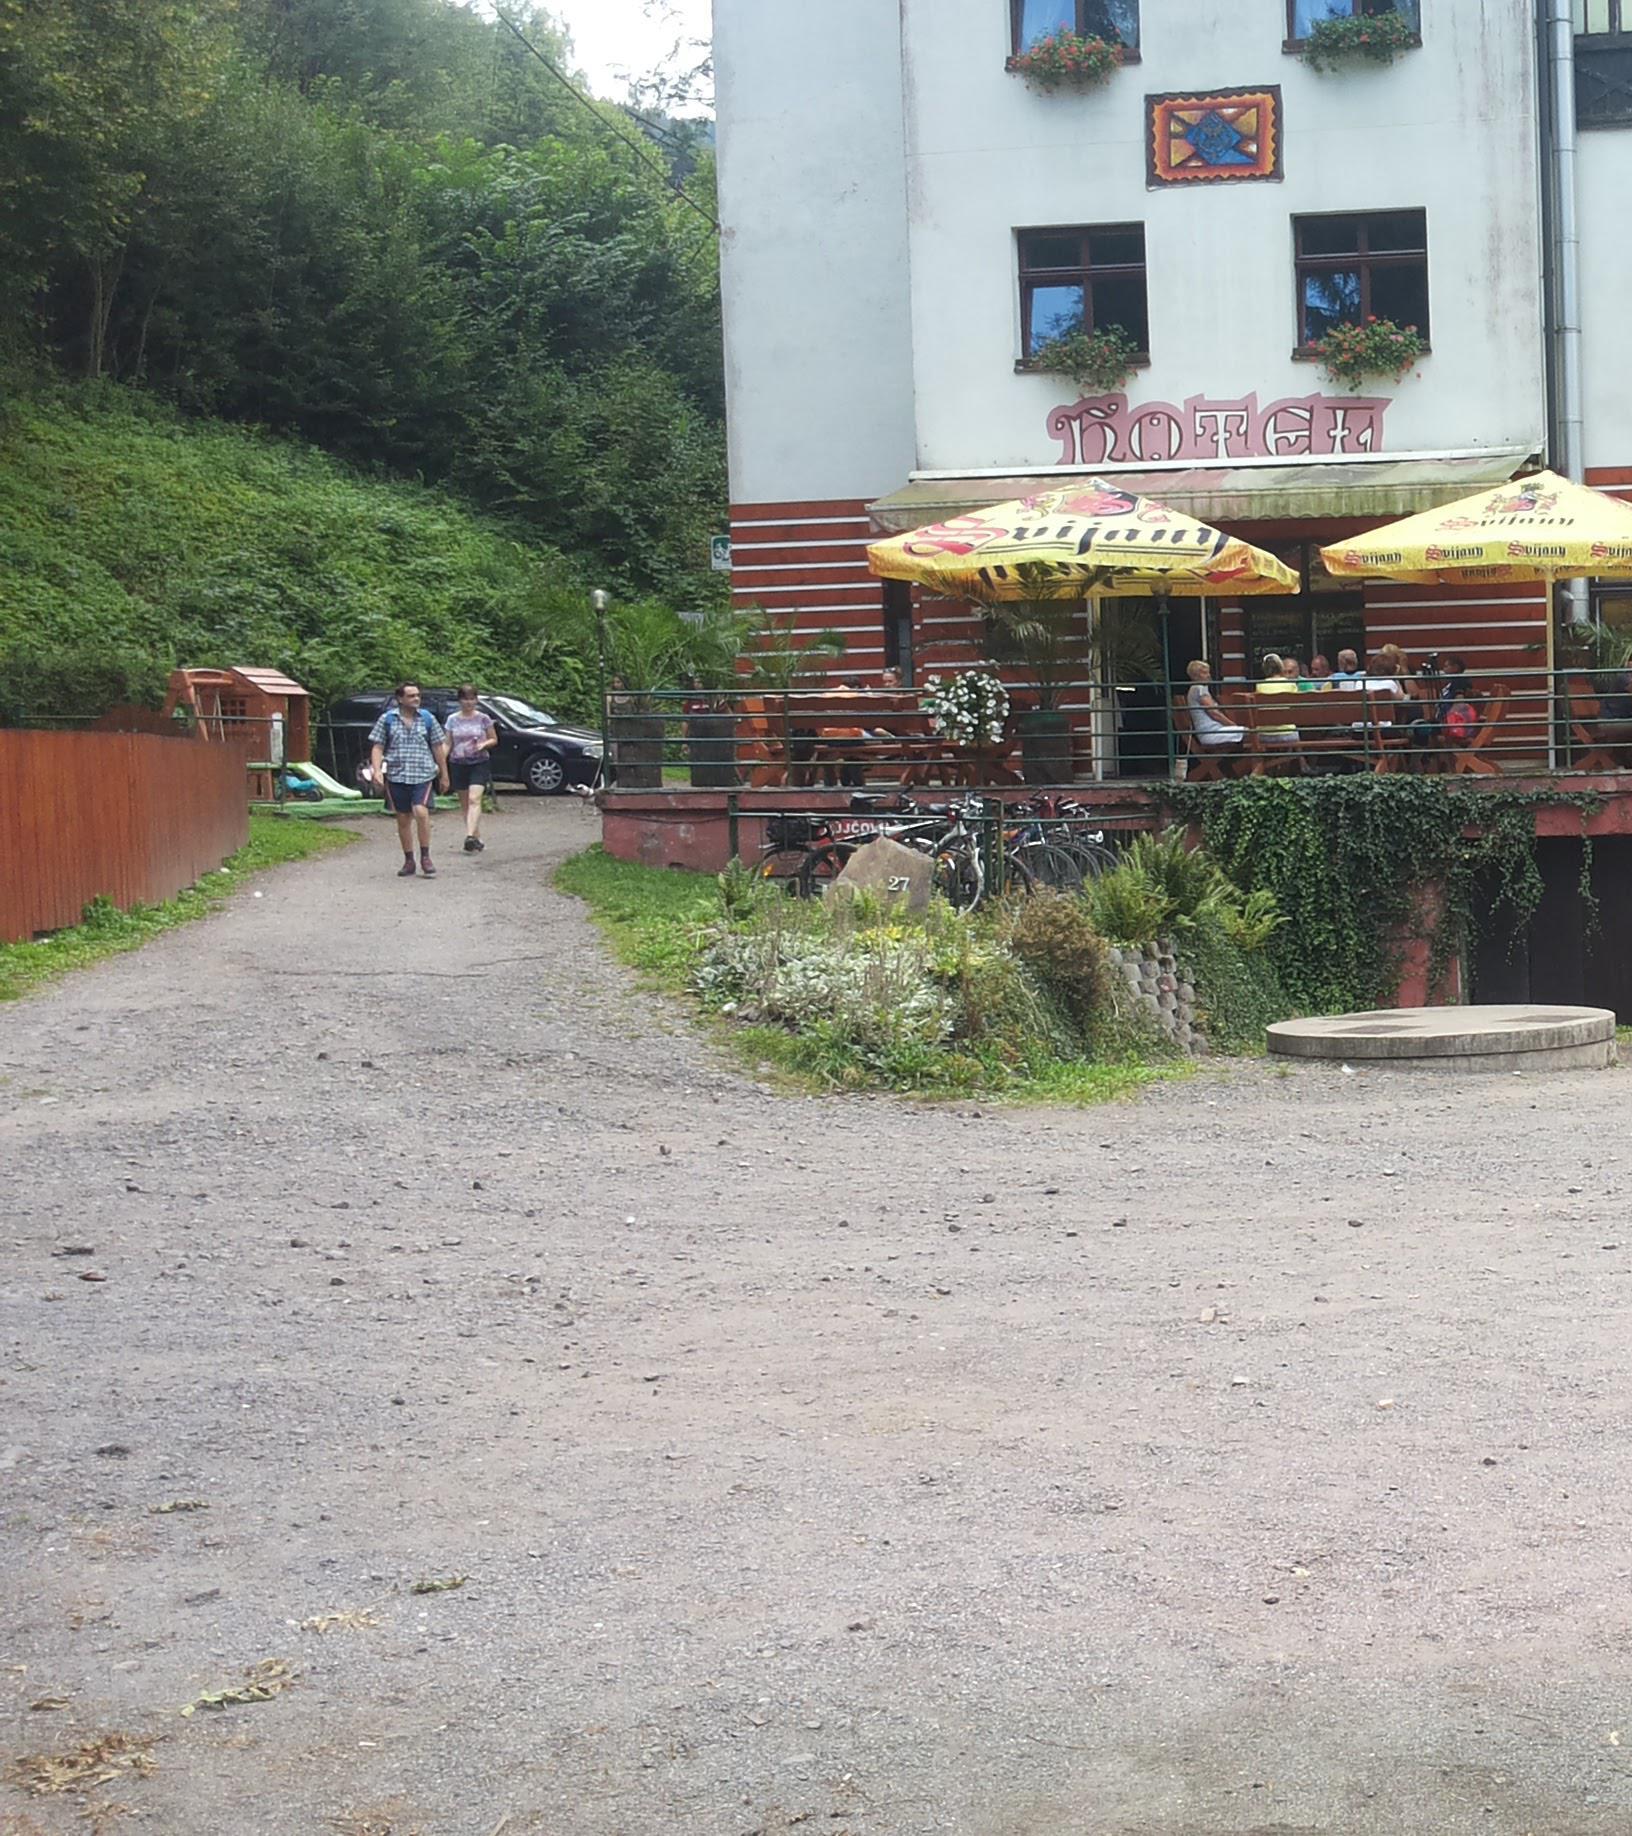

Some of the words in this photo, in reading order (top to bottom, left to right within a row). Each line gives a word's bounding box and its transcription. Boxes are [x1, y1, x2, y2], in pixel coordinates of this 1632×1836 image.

[1053, 398, 1380, 465] HOTEL
[903, 515, 1231, 561] Svijany
[1425, 544, 1484, 562] Svijany
[1507, 540, 1566, 559] Svijany
[1344, 550, 1402, 568] Svijany
[888, 876, 910, 892] 27
